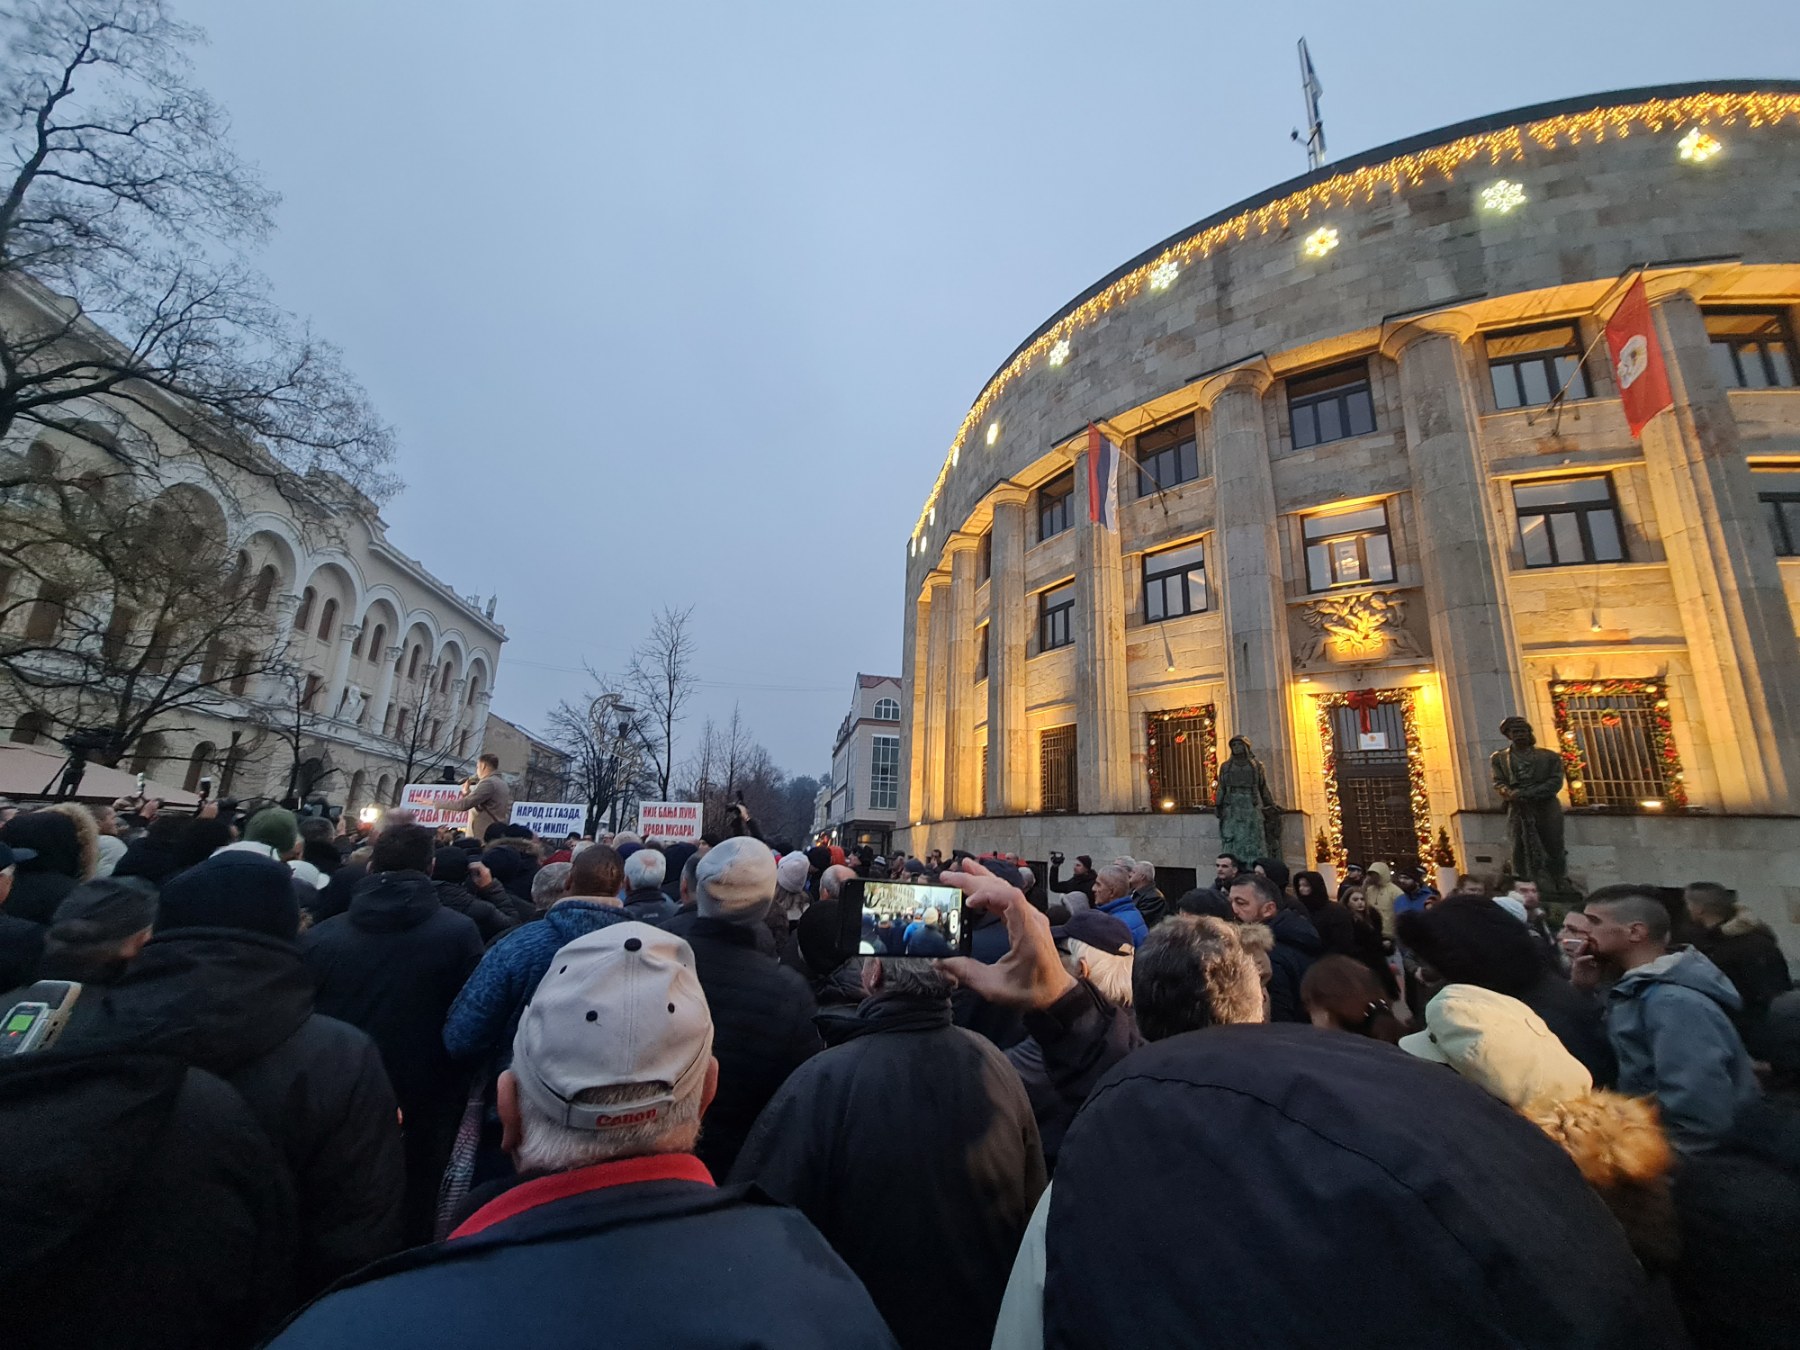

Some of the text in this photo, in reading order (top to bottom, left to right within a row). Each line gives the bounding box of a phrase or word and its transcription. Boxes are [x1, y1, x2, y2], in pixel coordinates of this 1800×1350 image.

[409, 809, 469, 823] РАВА МУЗА
[516, 806, 545, 819] НАРОД
[554, 808, 580, 820] ГАЗДА
[643, 806, 657, 818] НИЈЕ
[658, 807, 677, 818] БАЊА
[643, 824, 695, 836] КРАВА МУЗАРА!
[596, 1109, 657, 1127] Canon
